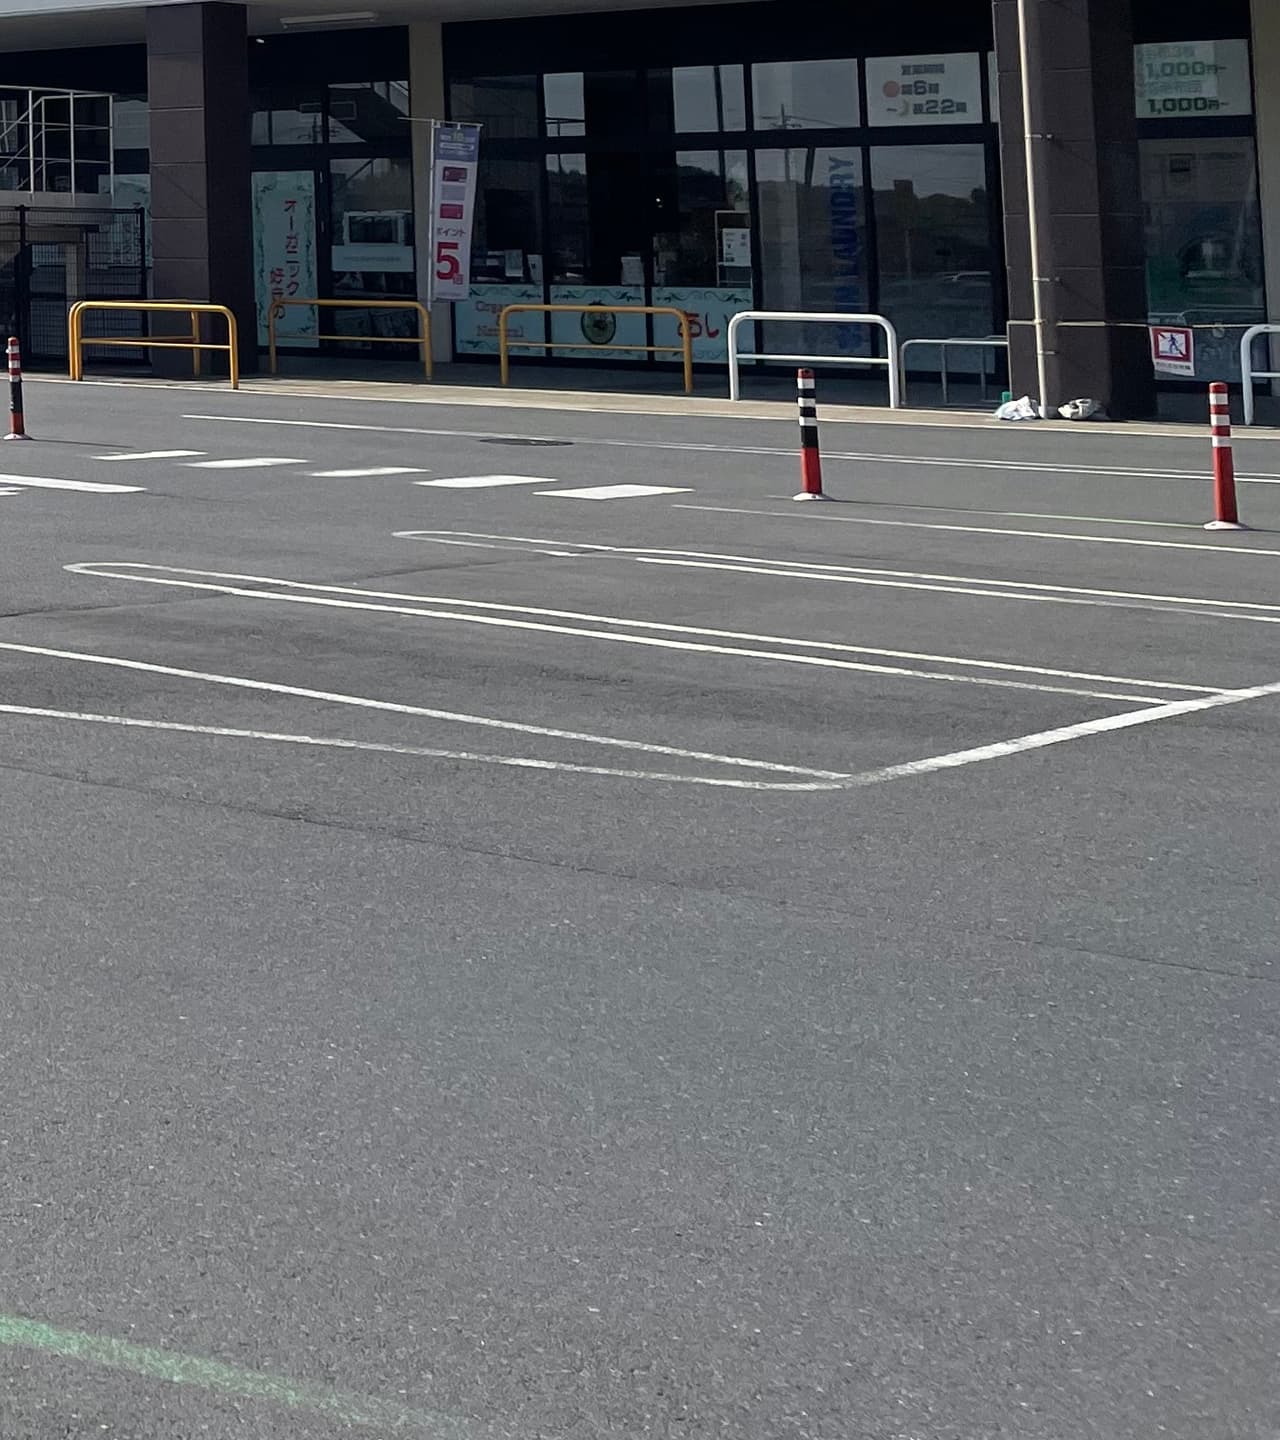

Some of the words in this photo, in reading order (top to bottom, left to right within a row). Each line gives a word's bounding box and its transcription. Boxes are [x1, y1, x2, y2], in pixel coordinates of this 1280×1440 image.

[284, 200, 300, 296] オーガニック
